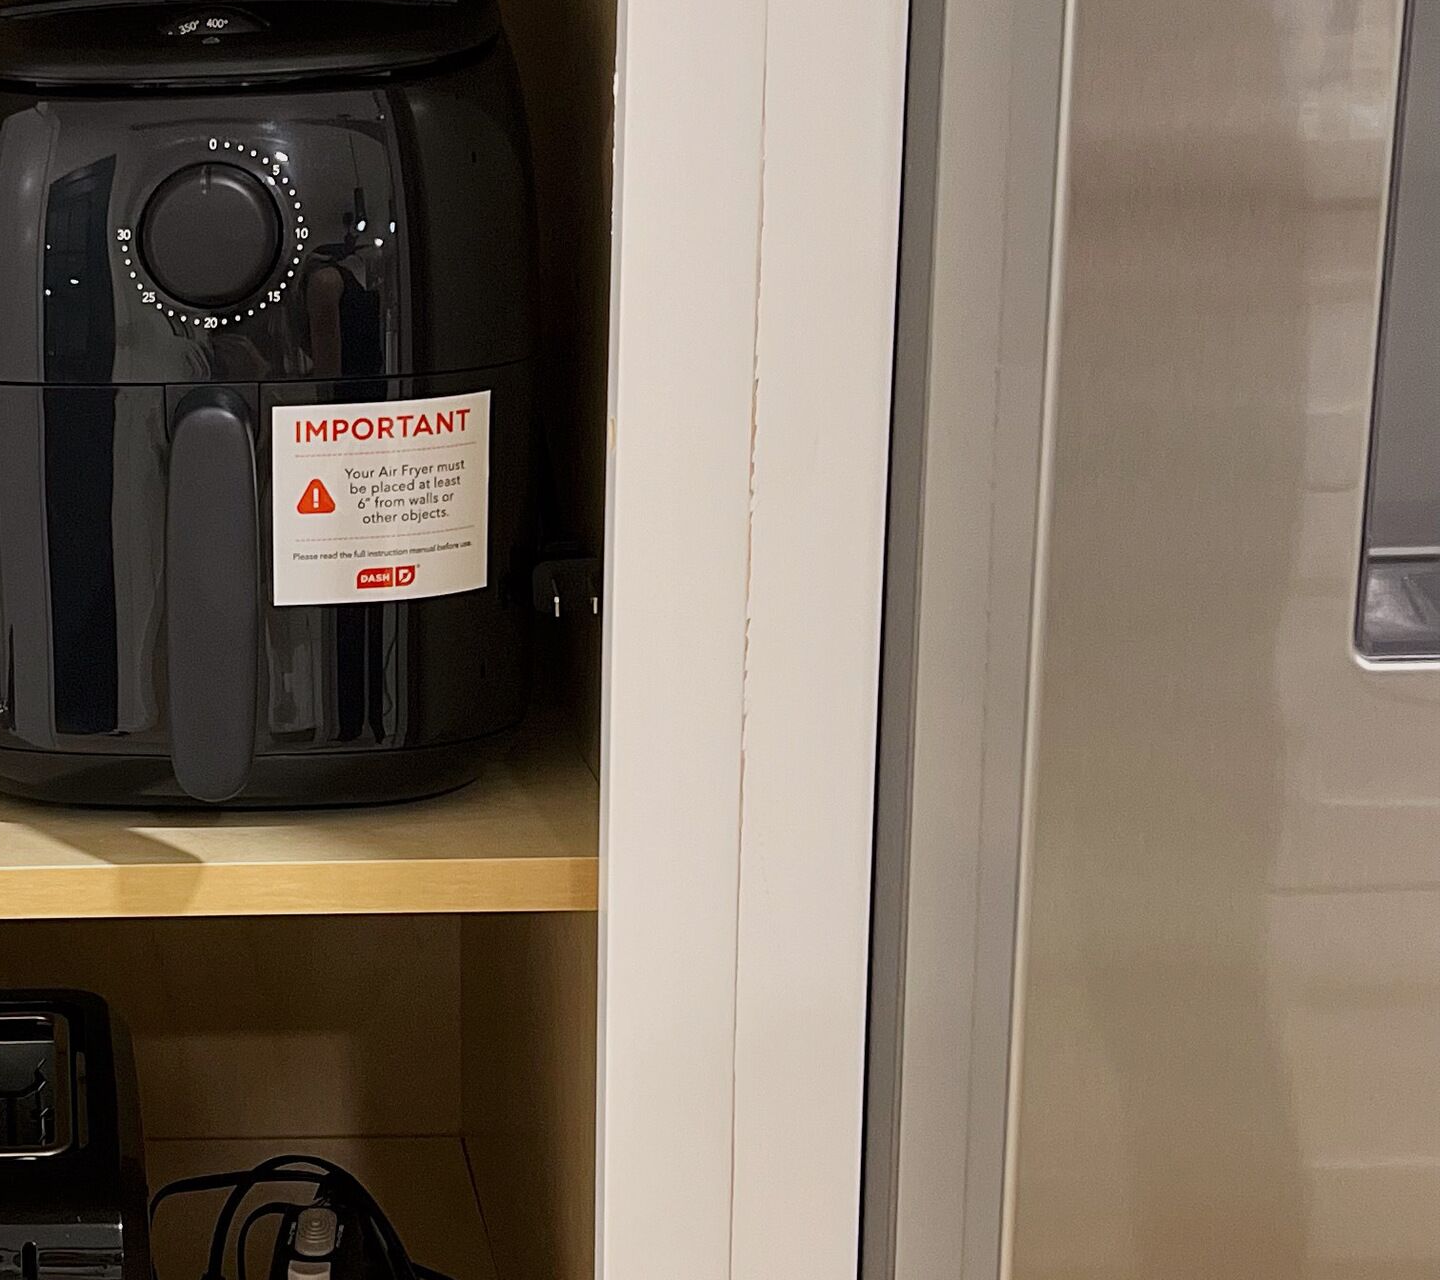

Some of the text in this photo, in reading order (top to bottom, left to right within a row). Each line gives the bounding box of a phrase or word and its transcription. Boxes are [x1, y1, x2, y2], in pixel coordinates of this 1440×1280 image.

[209, 138, 218, 150] 0
[272, 165, 281, 176] 5
[117, 229, 131, 241] 30
[295, 227, 309, 239] 10
[142, 291, 156, 303] 25
[267, 291, 281, 302] 15
[204, 317, 218, 329] 20
[295, 408, 471, 443] IMPORTANT
[345, 459, 465, 480] Your Air Fryer must
[350, 475, 461, 497] be placed at least
[375, 494, 405, 507] from
[409, 492, 439, 505] walls
[442, 492, 454, 502] or
[363, 508, 449, 524] other objects.
[293, 552, 318, 561] Please
[320, 551, 338, 560] read
[339, 550, 352, 559] the
[353, 549, 366, 558] full
[368, 548, 408, 557] instruction
[410, 544, 436, 554] manual
[437, 542, 459, 552] before
[360, 573, 390, 584] DASH
